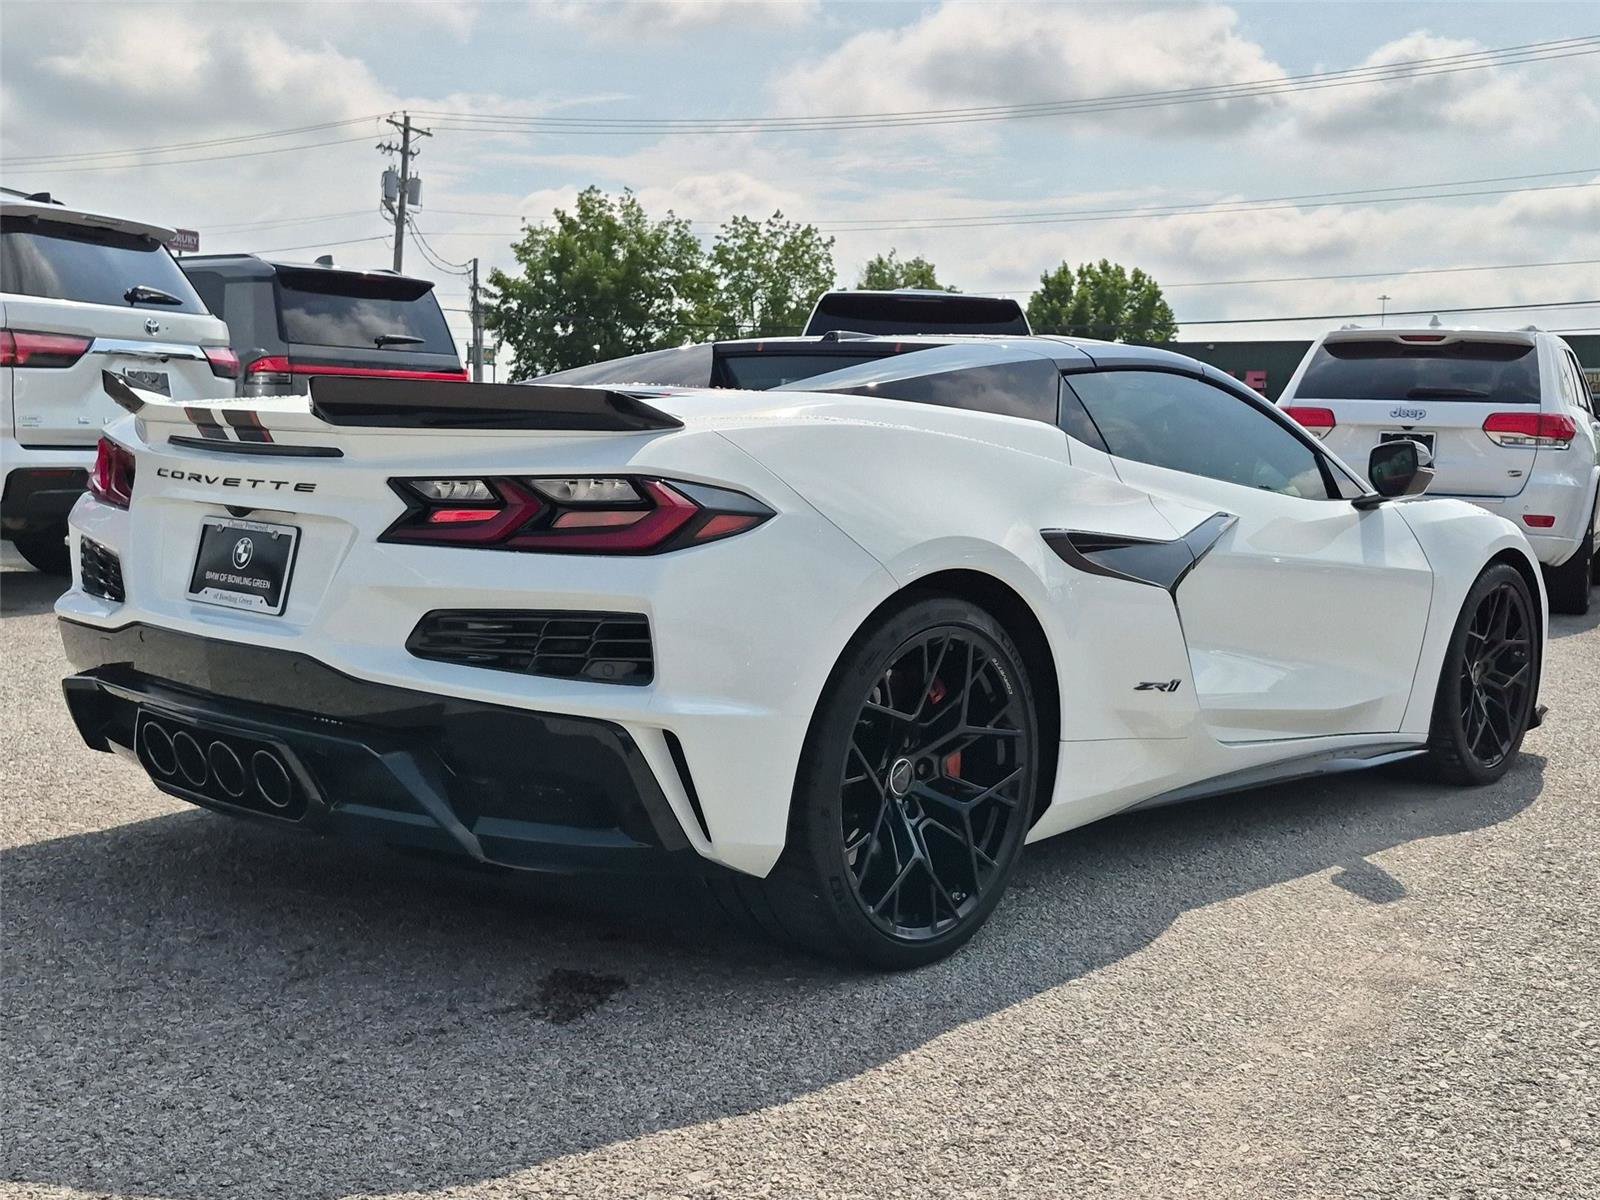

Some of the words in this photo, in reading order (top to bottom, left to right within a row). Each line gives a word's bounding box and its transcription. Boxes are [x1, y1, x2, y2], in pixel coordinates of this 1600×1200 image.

[1390, 406, 1426, 420] Jeep
[157, 467, 317, 493] CORVETTE
[206, 571, 219, 580] BMW
[220, 573, 228, 581] OF
[228, 575, 252, 586] BOWLING
[253, 579, 270, 589] GREEN
